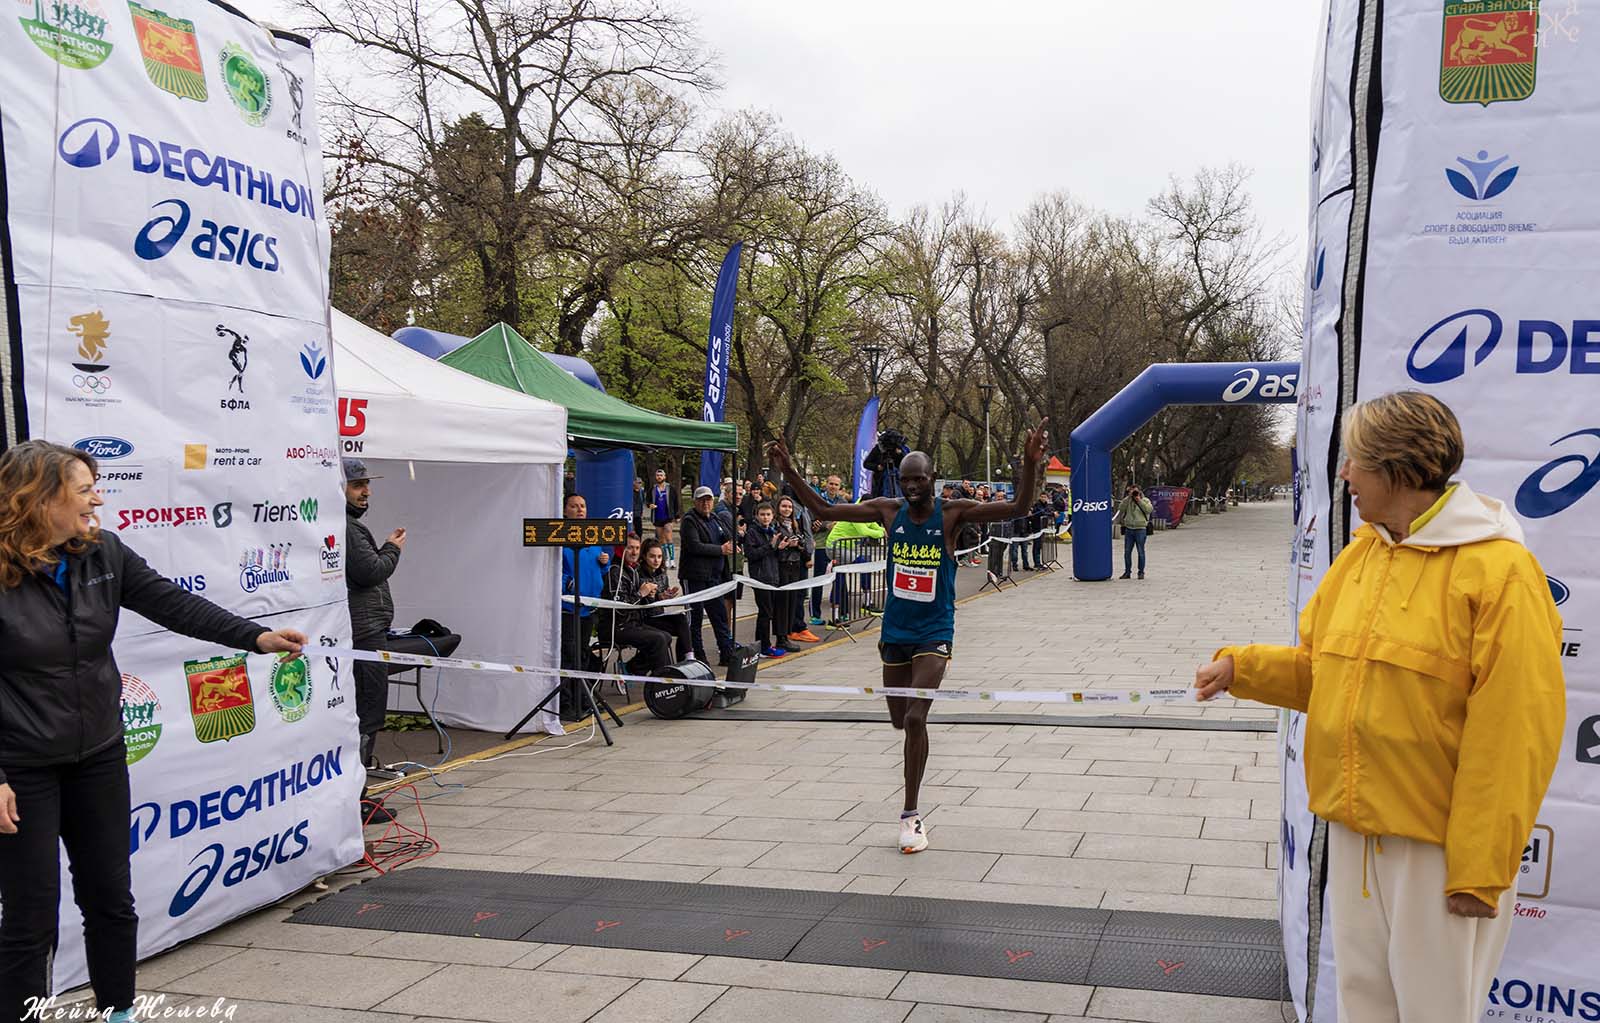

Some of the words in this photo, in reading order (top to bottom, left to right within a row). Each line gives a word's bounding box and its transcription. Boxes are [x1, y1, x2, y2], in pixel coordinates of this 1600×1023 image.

[1445, 3, 1485, 15] СТАРА
[128, 134, 315, 221] DECATHLON
[191, 219, 280, 272] asics
[708, 335, 722, 404] asics
[1259, 374, 1297, 398] as
[220, 399, 250, 411] БФЛА
[85, 440, 122, 456] Ford
[213, 456, 236, 466] rent
[238, 458, 245, 466] a
[246, 457, 263, 466] car
[253, 500, 298, 522] Tiens
[1082, 500, 1109, 512] asics
[117, 506, 207, 531] SPONSER
[910, 559, 941, 567] marathon
[907, 577, 918, 590] 3
[655, 685, 685, 699] MYLAPS
[123, 730, 157, 744] THON
[169, 746, 344, 838] DECATHLON
[222, 819, 310, 888] asics
[1486, 1009, 1505, 1018] OF
